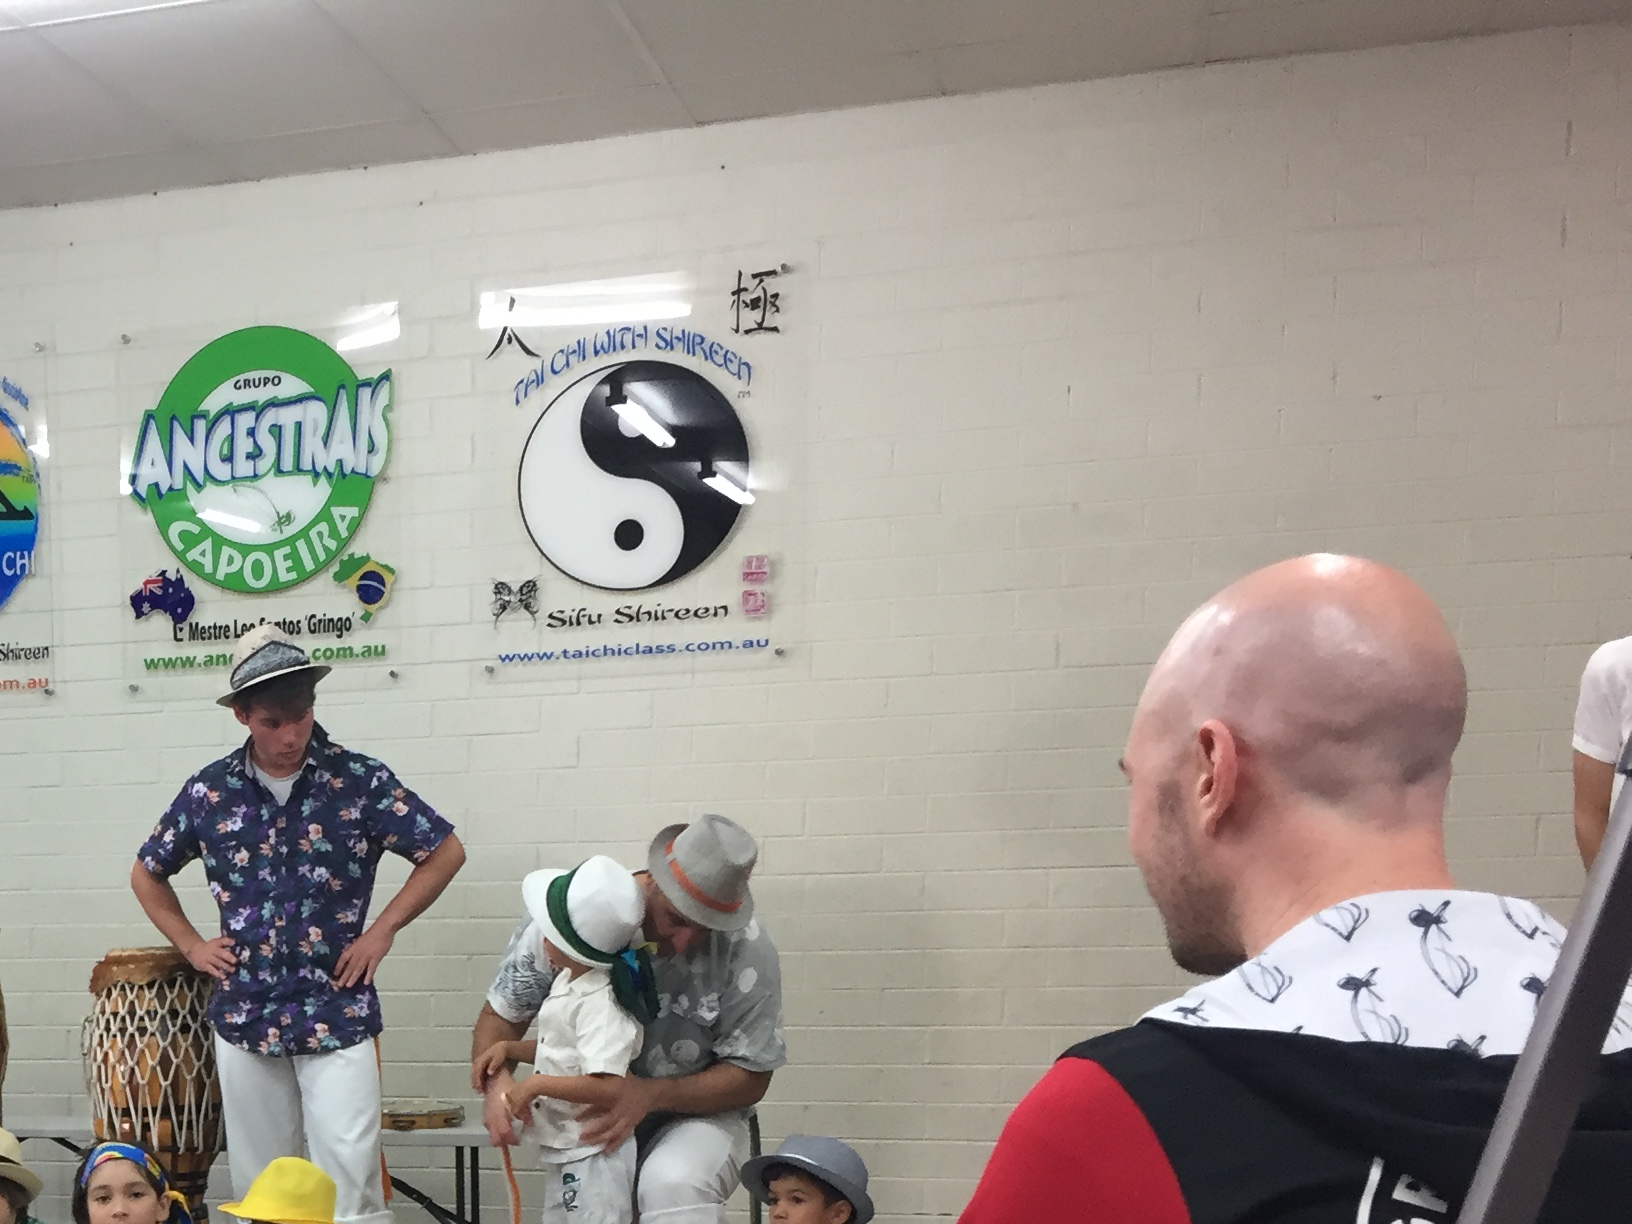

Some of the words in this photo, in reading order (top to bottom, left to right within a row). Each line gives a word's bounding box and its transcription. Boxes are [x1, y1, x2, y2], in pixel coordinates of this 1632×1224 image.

[513, 359, 545, 406] TAI
[550, 337, 587, 375] CHI
[593, 324, 648, 357] WITH
[232, 374, 282, 391] GRUPO
[133, 372, 391, 503] ANCESTRAIS
[167, 505, 360, 589] CAPOEIRA
[2, 550, 36, 576] CHI
[546, 607, 603, 629] Sifu
[613, 602, 730, 625] Shireen
[188, 620, 231, 642] Mestre
[498, 637, 770, 663] www.taichiclass.com.au
